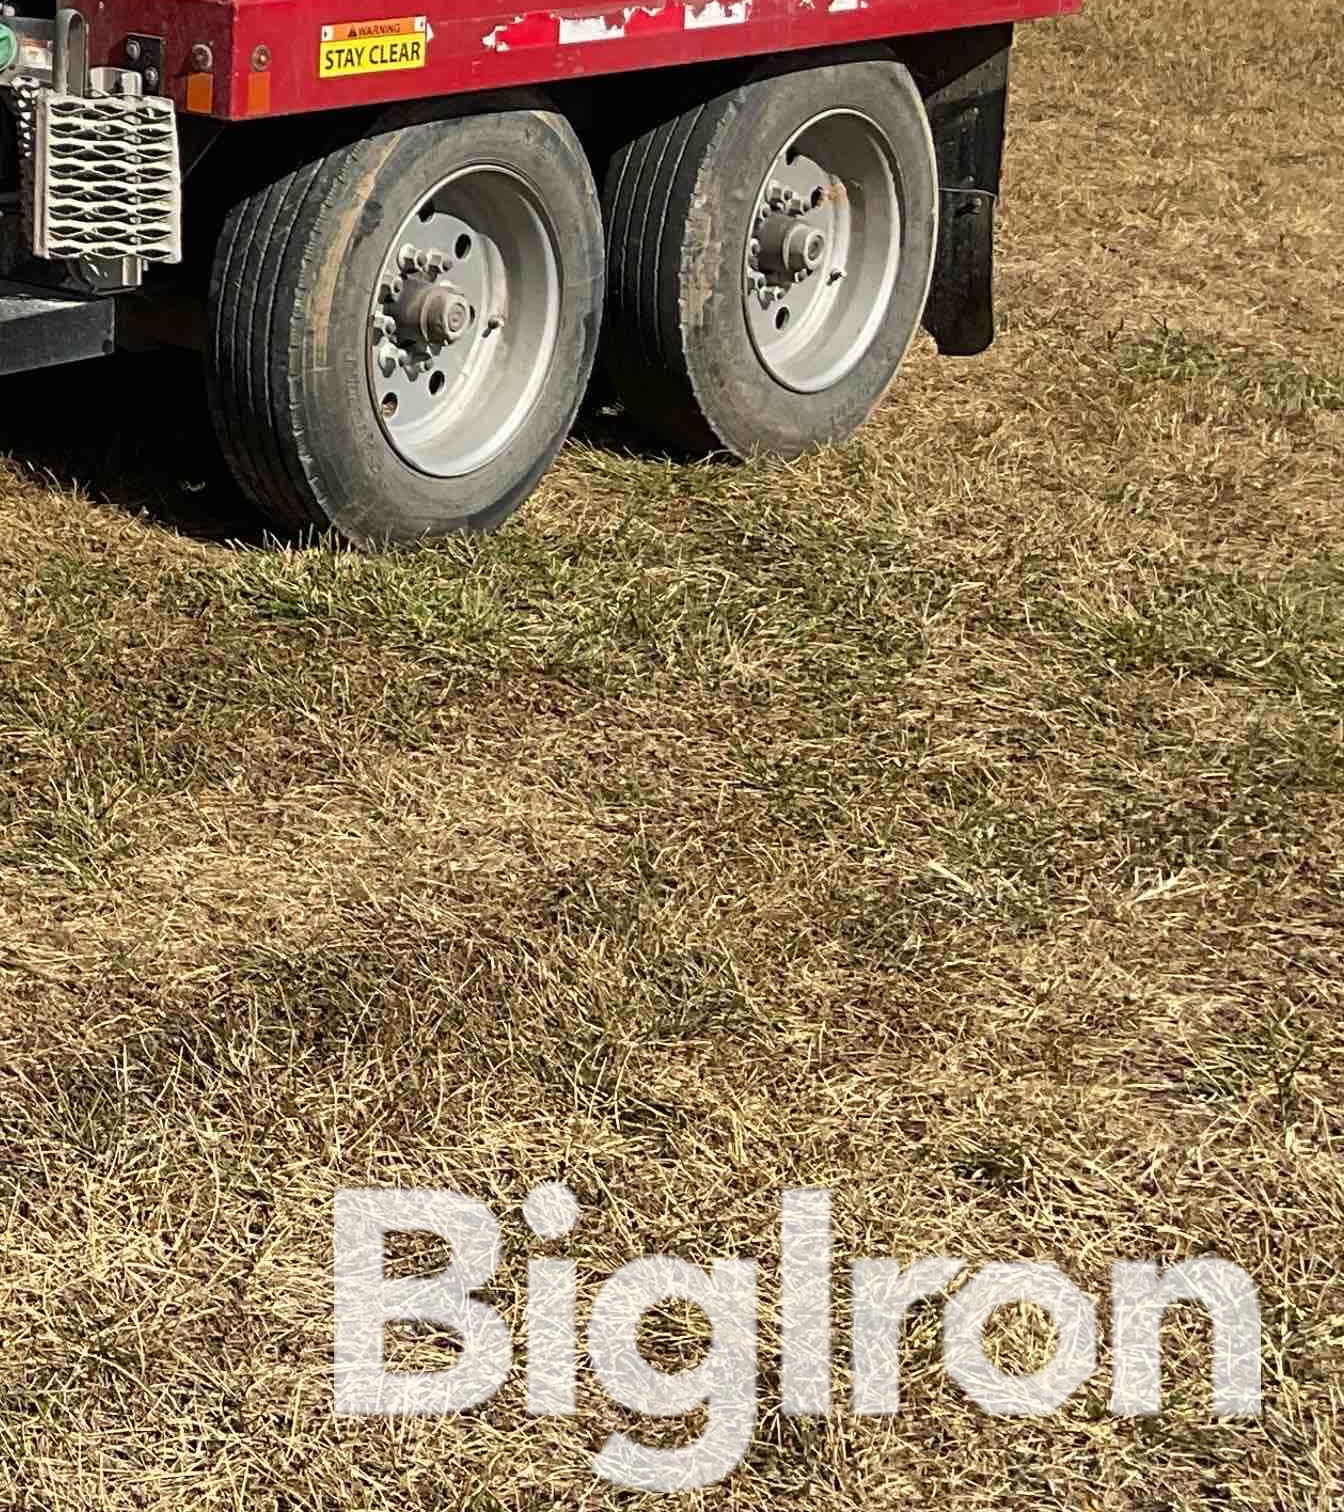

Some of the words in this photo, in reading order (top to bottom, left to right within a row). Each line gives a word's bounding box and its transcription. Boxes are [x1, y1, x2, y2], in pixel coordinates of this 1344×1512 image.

[358, 23, 400, 36] WARNING
[325, 47, 366, 70] STAY
[369, 41, 421, 65] CLEAR
